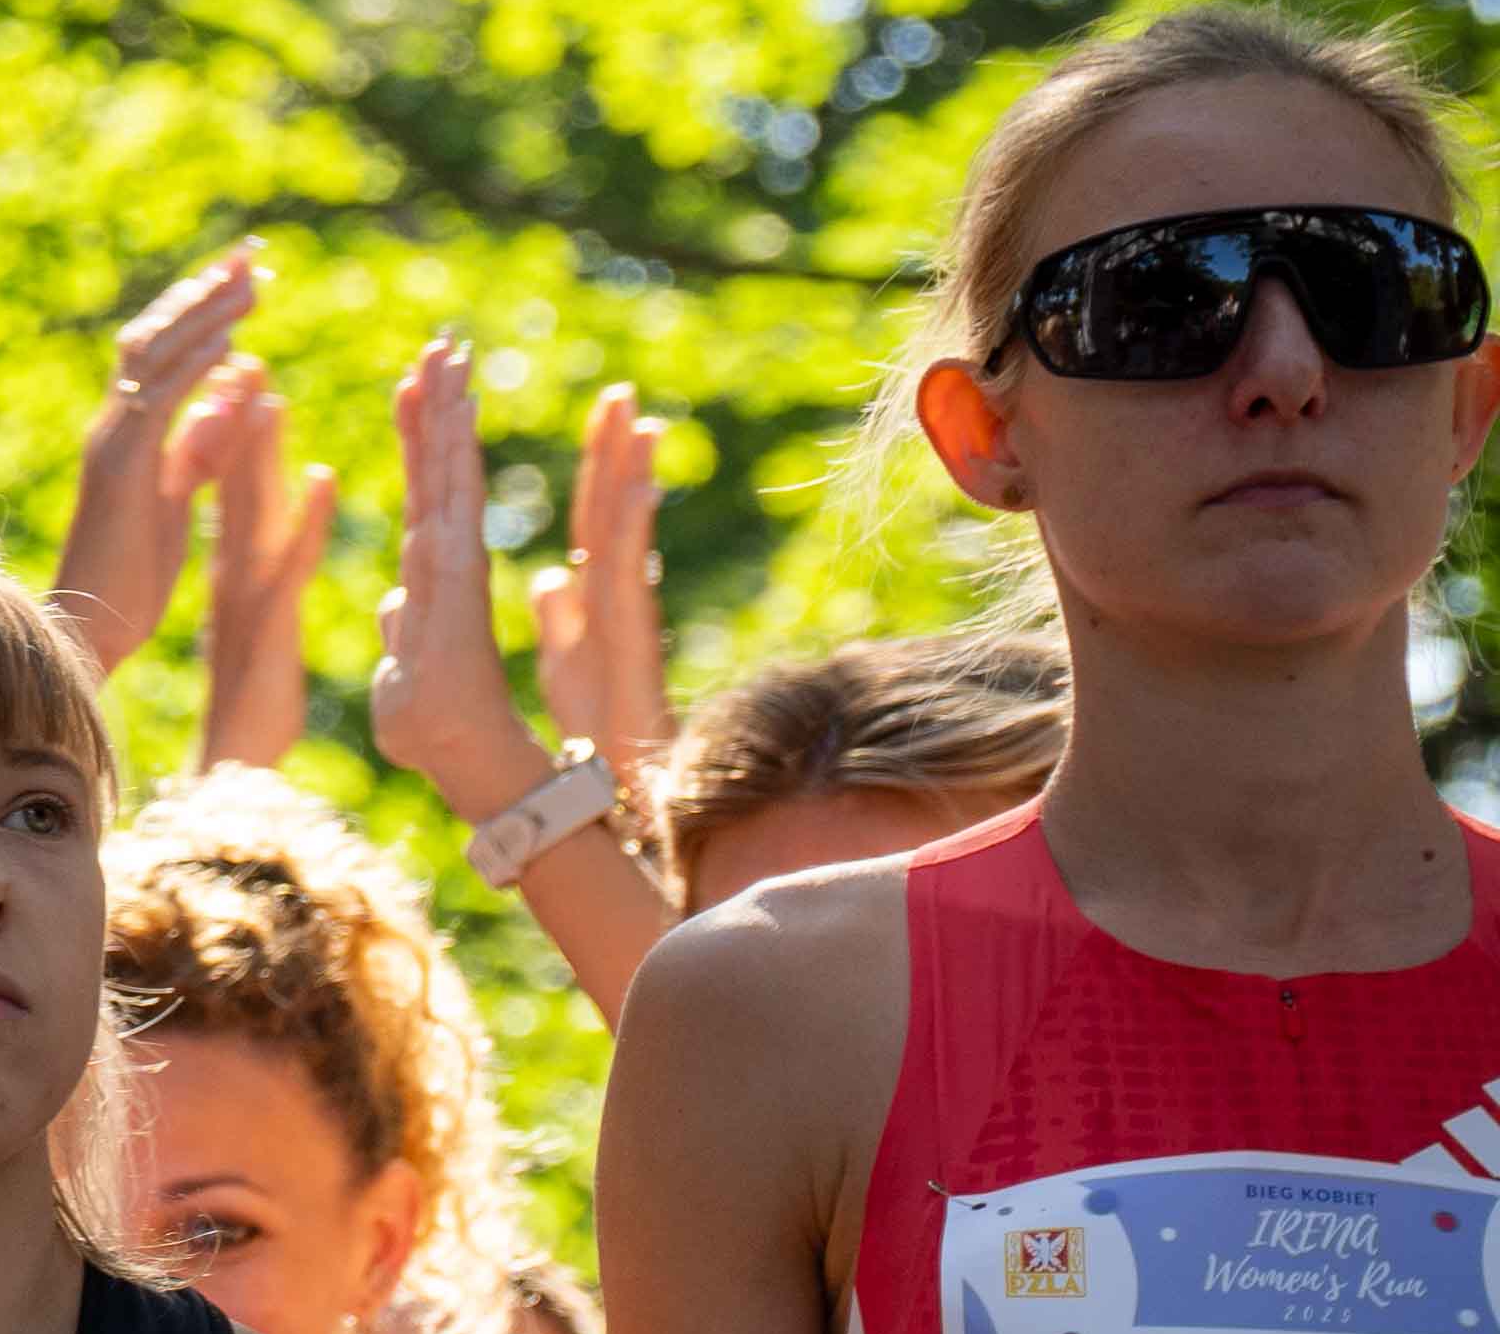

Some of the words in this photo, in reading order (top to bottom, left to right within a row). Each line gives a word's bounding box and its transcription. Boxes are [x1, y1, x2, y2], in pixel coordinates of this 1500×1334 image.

[1245, 1184, 1293, 1201] BIEG
[1301, 1188, 1377, 1207] KOBIET
[1247, 1209, 1380, 1259] IRENA
[1009, 1274, 1081, 1294] PZLA
[1204, 1253, 1348, 1302] Women's
[1356, 1261, 1428, 1307] Run
[1283, 1304, 1352, 1324] 2025
